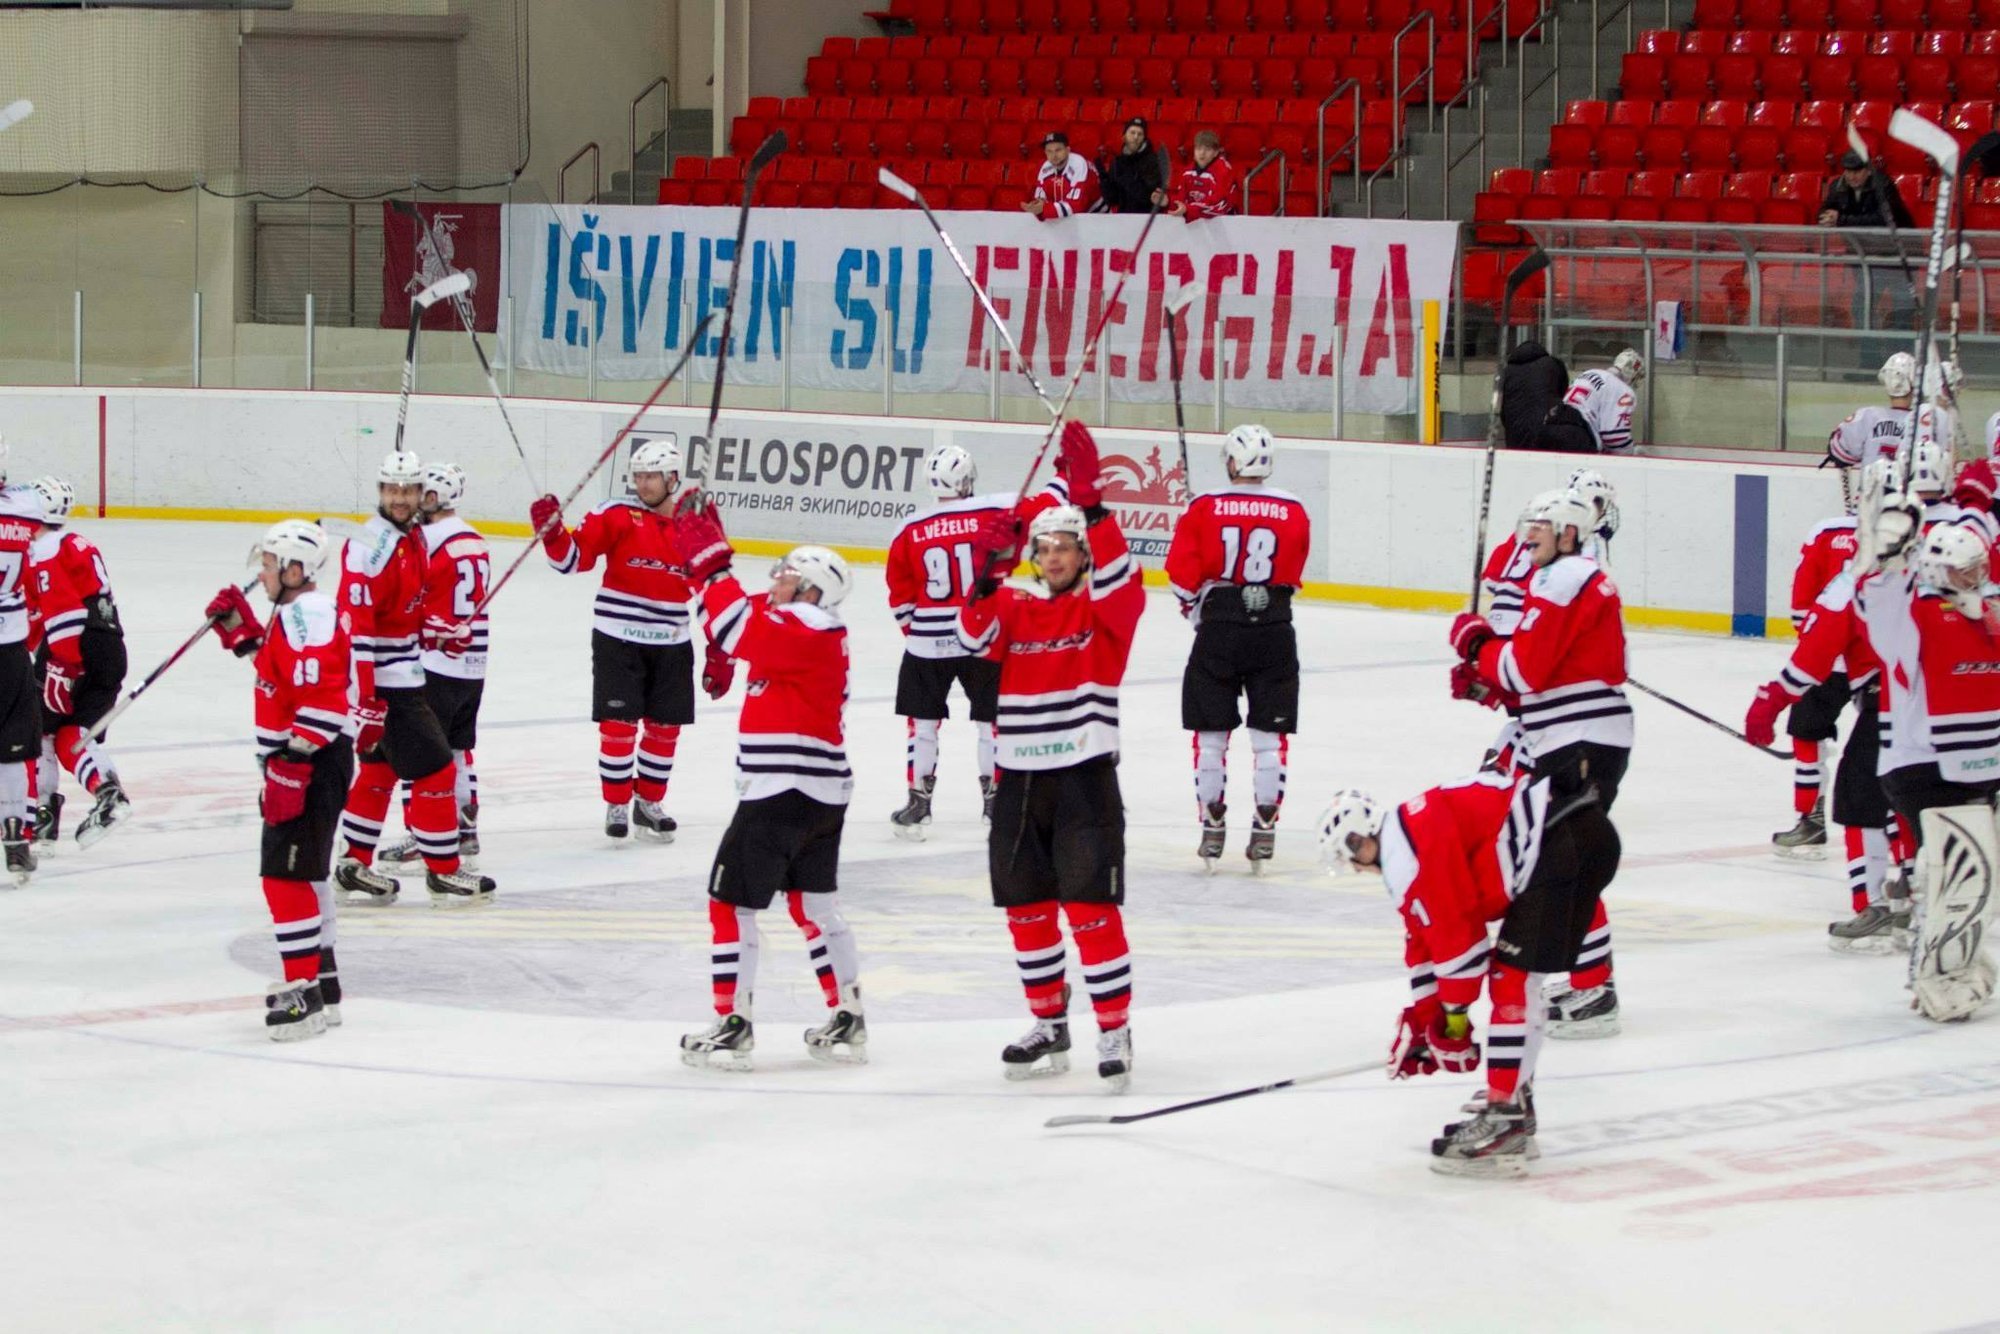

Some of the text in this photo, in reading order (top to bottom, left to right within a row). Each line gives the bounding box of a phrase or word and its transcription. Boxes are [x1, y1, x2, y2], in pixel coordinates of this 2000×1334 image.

[542, 213, 796, 362] IŠVIEN
[830, 246, 932, 374] SU
[965, 243, 1414, 382] ENERGIJA
[685, 436, 924, 492] DELOSPORT
[704, 491, 793, 513] ортивная
[1214, 498, 1288, 520] ŽIDKOVAS
[923, 543, 975, 599] 91
[1220, 526, 1276, 583] 18
